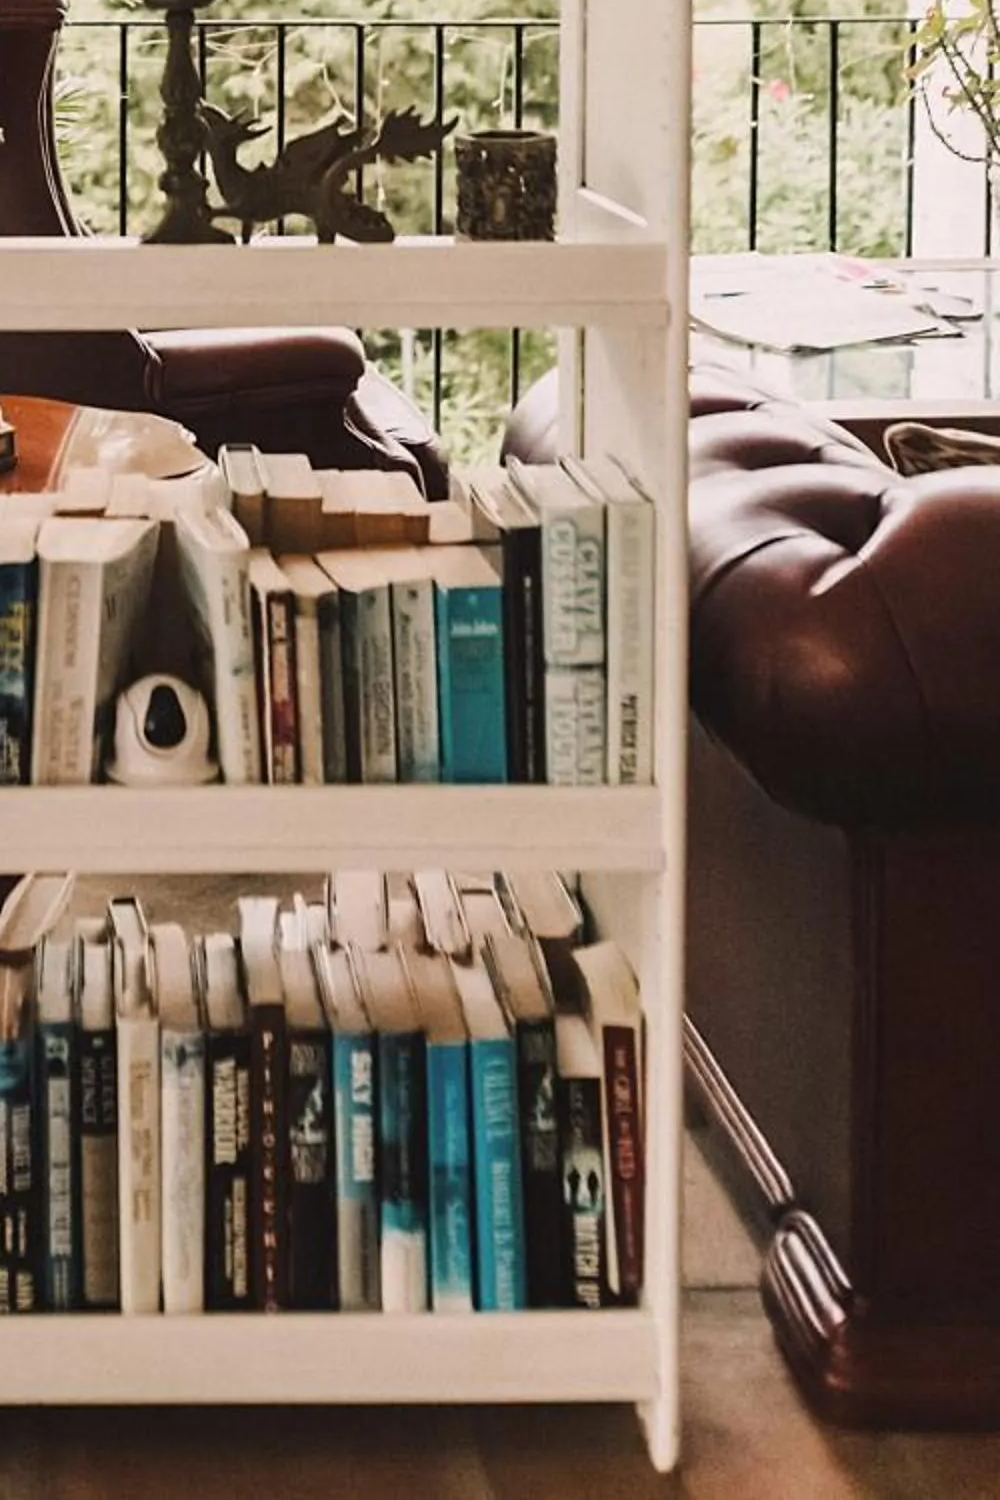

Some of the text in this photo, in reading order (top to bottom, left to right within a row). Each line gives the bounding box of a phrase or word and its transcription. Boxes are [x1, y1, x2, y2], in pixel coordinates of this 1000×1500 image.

[550, 521, 576, 652] CUSSLER
[213, 1056, 237, 1166] WARRIOR
[351, 1049, 374, 1108] SKY
[574, 1213, 599, 1277] MATCH
